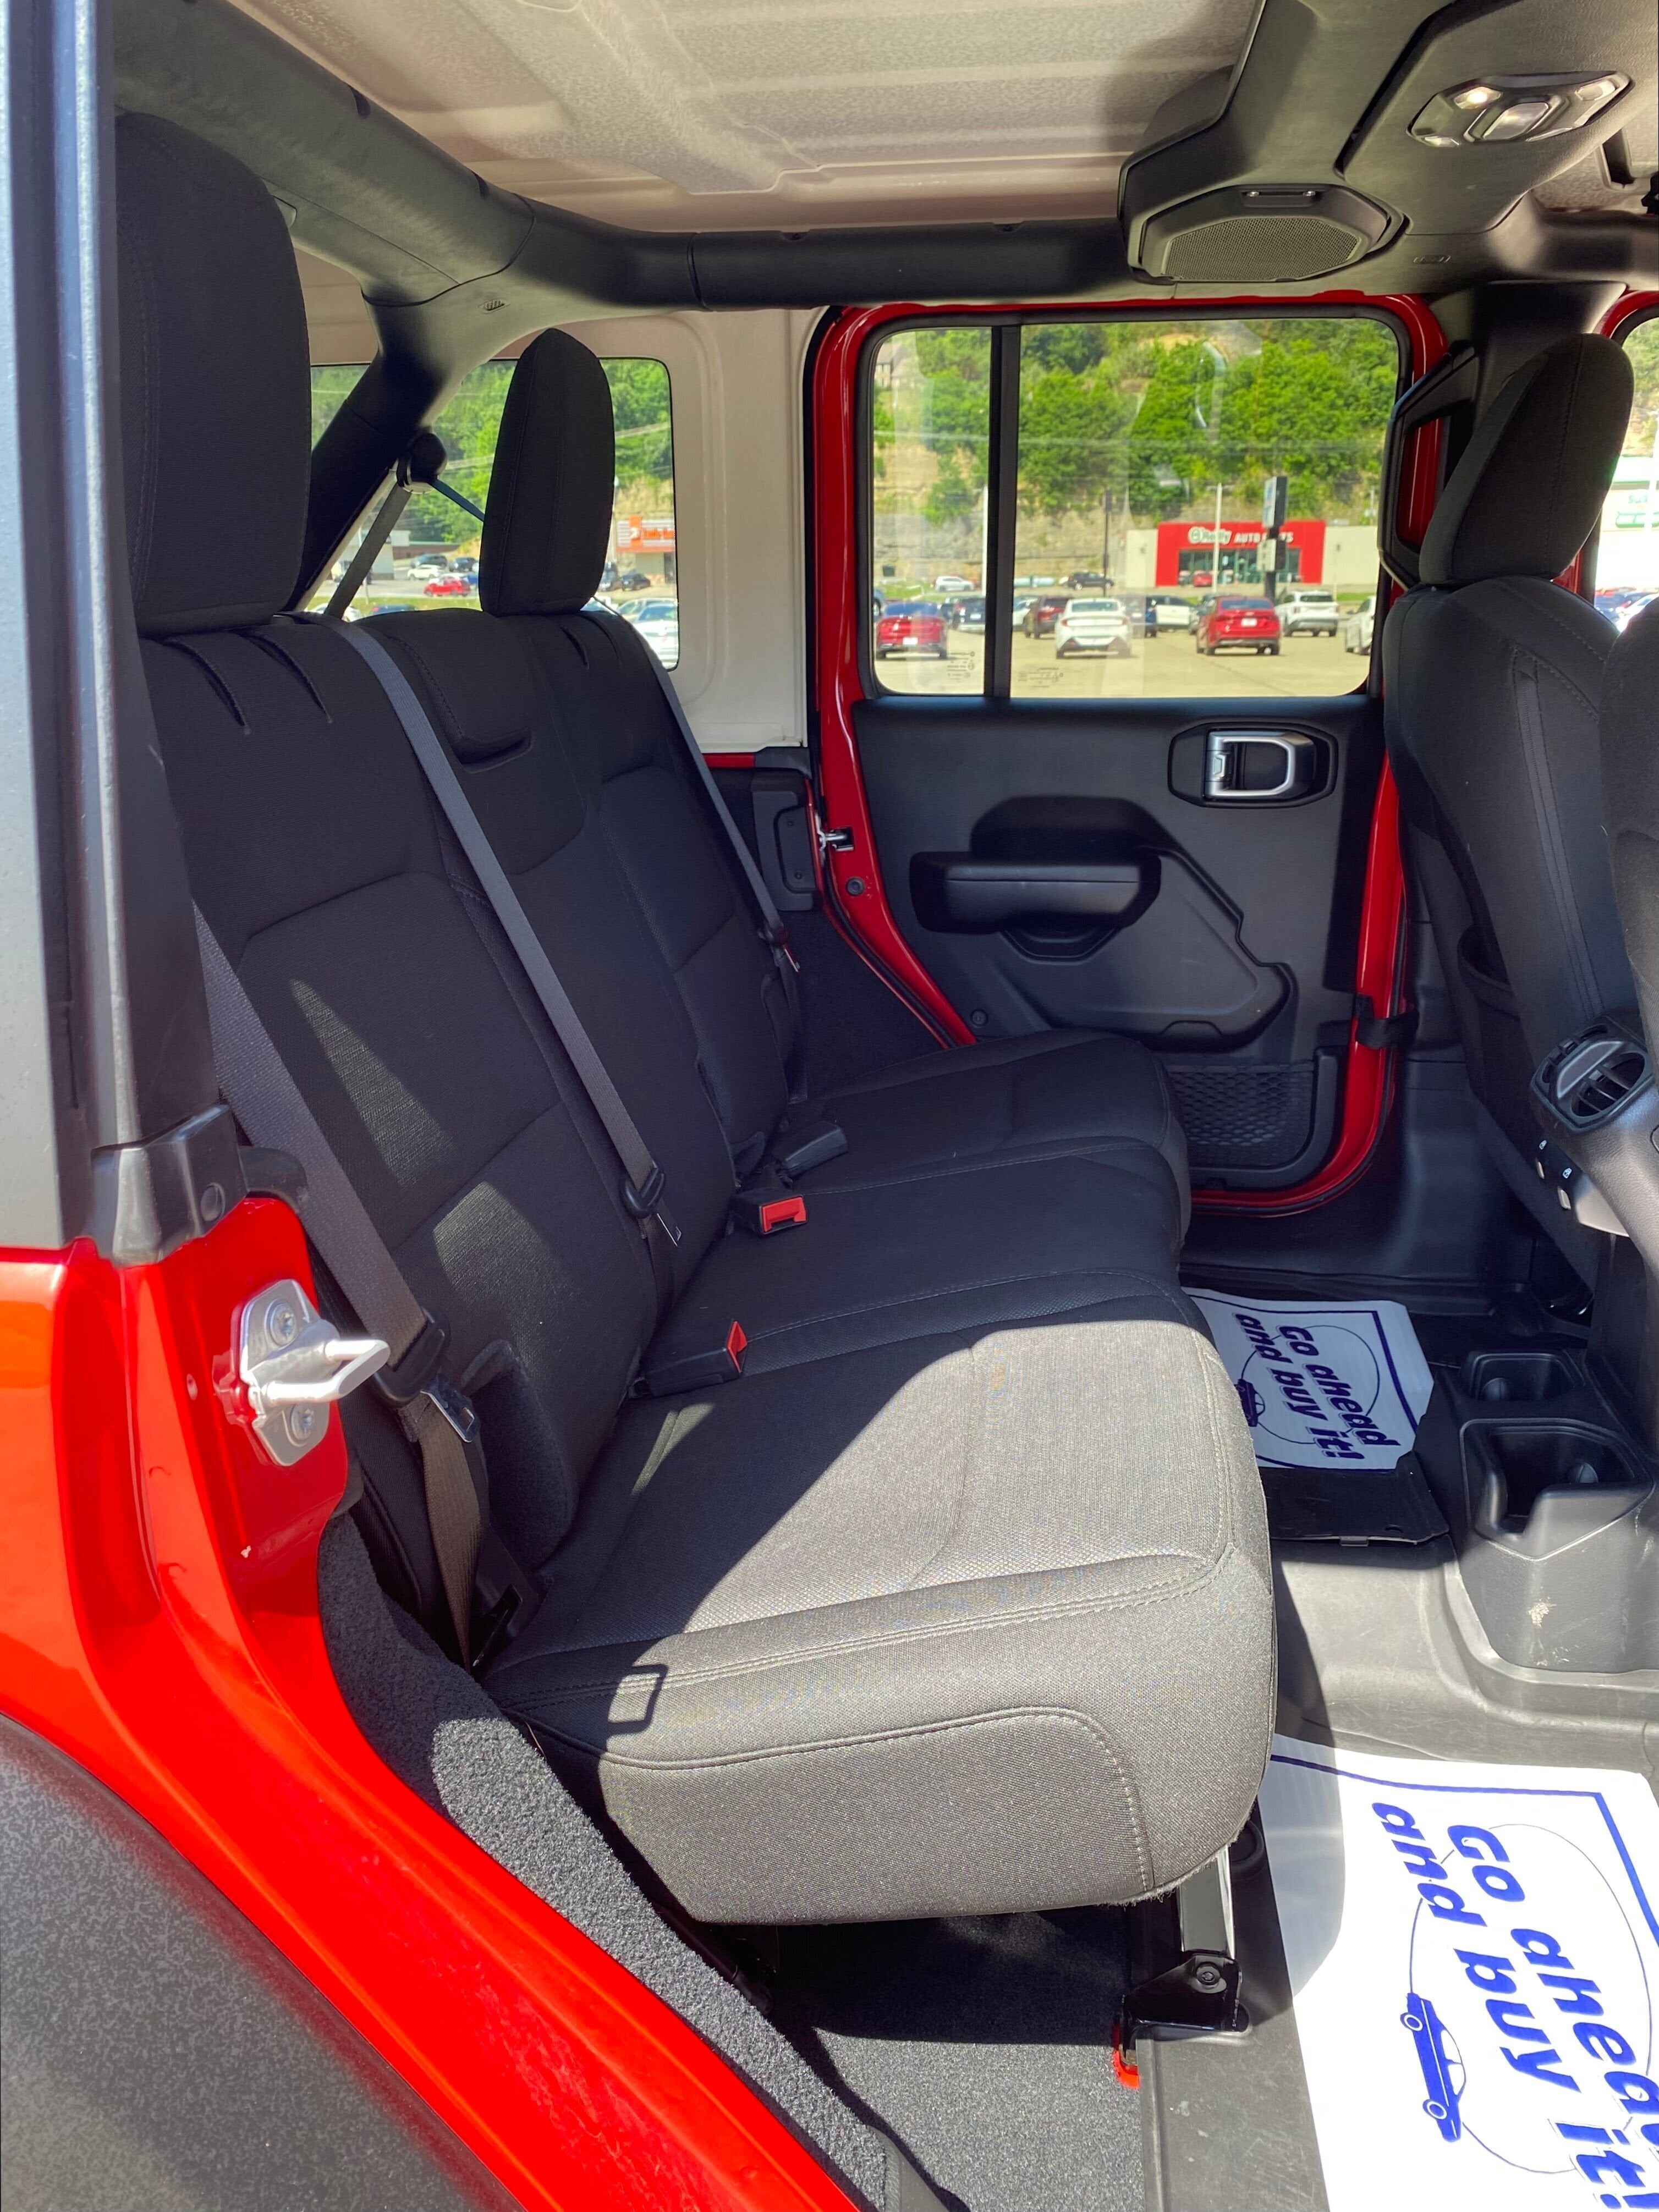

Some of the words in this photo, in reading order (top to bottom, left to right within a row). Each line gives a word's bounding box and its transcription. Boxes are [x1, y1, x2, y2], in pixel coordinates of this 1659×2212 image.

[1189, 526, 1232, 544] O'Relly
[1234, 532, 1261, 543] AUTO
[1234, 1313, 1294, 1364] and
[1268, 1367, 1328, 1421] buy
[1306, 1426, 1365, 1459] it!
[1276, 1325, 1319, 1356] Go
[1304, 1363, 1401, 1446] ahead
[1447, 1824, 1525, 1903] Go
[1371, 1802, 1487, 1927] and
[1454, 1947, 1583, 2093] buy
[1554, 2121, 1659, 2210] it!
